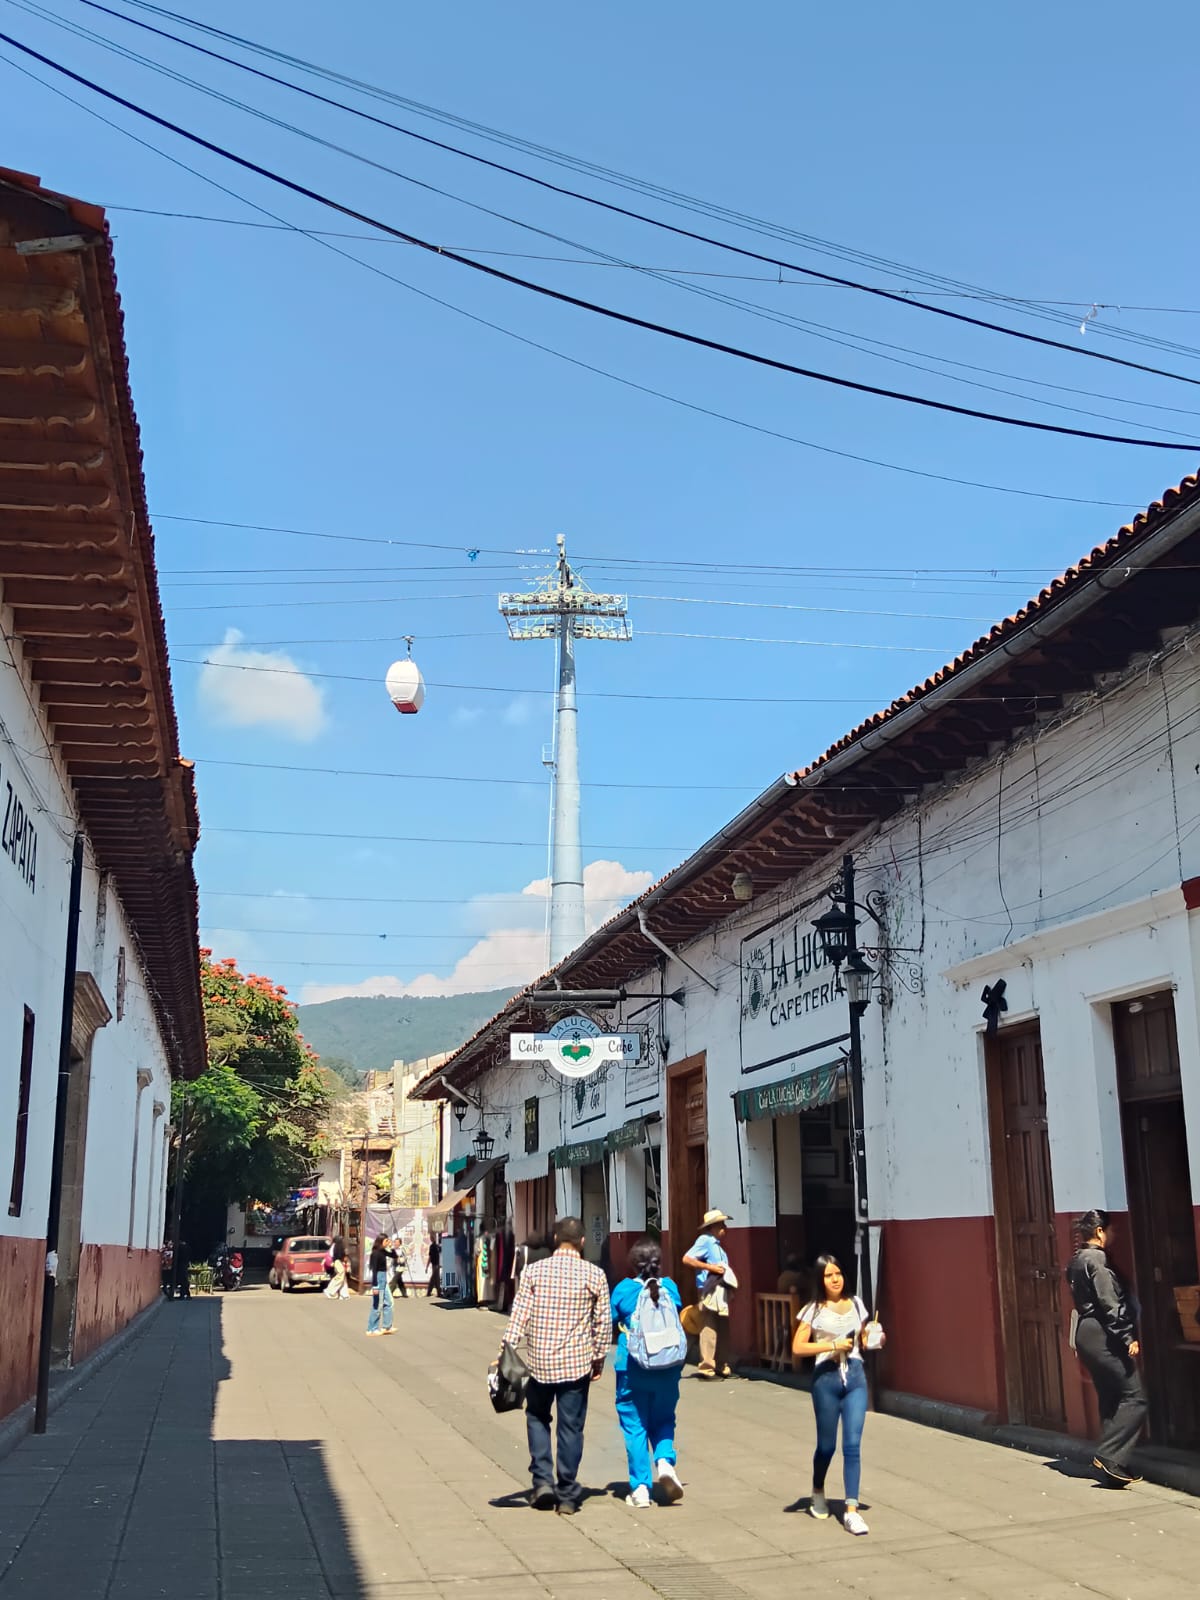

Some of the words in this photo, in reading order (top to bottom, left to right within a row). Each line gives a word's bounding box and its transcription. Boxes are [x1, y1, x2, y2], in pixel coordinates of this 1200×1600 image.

[2, 780, 37, 894] ZAPATA
[771, 937, 788, 990] LA
[518, 1039, 544, 1054] Café
[608, 1039, 633, 1054] Café
